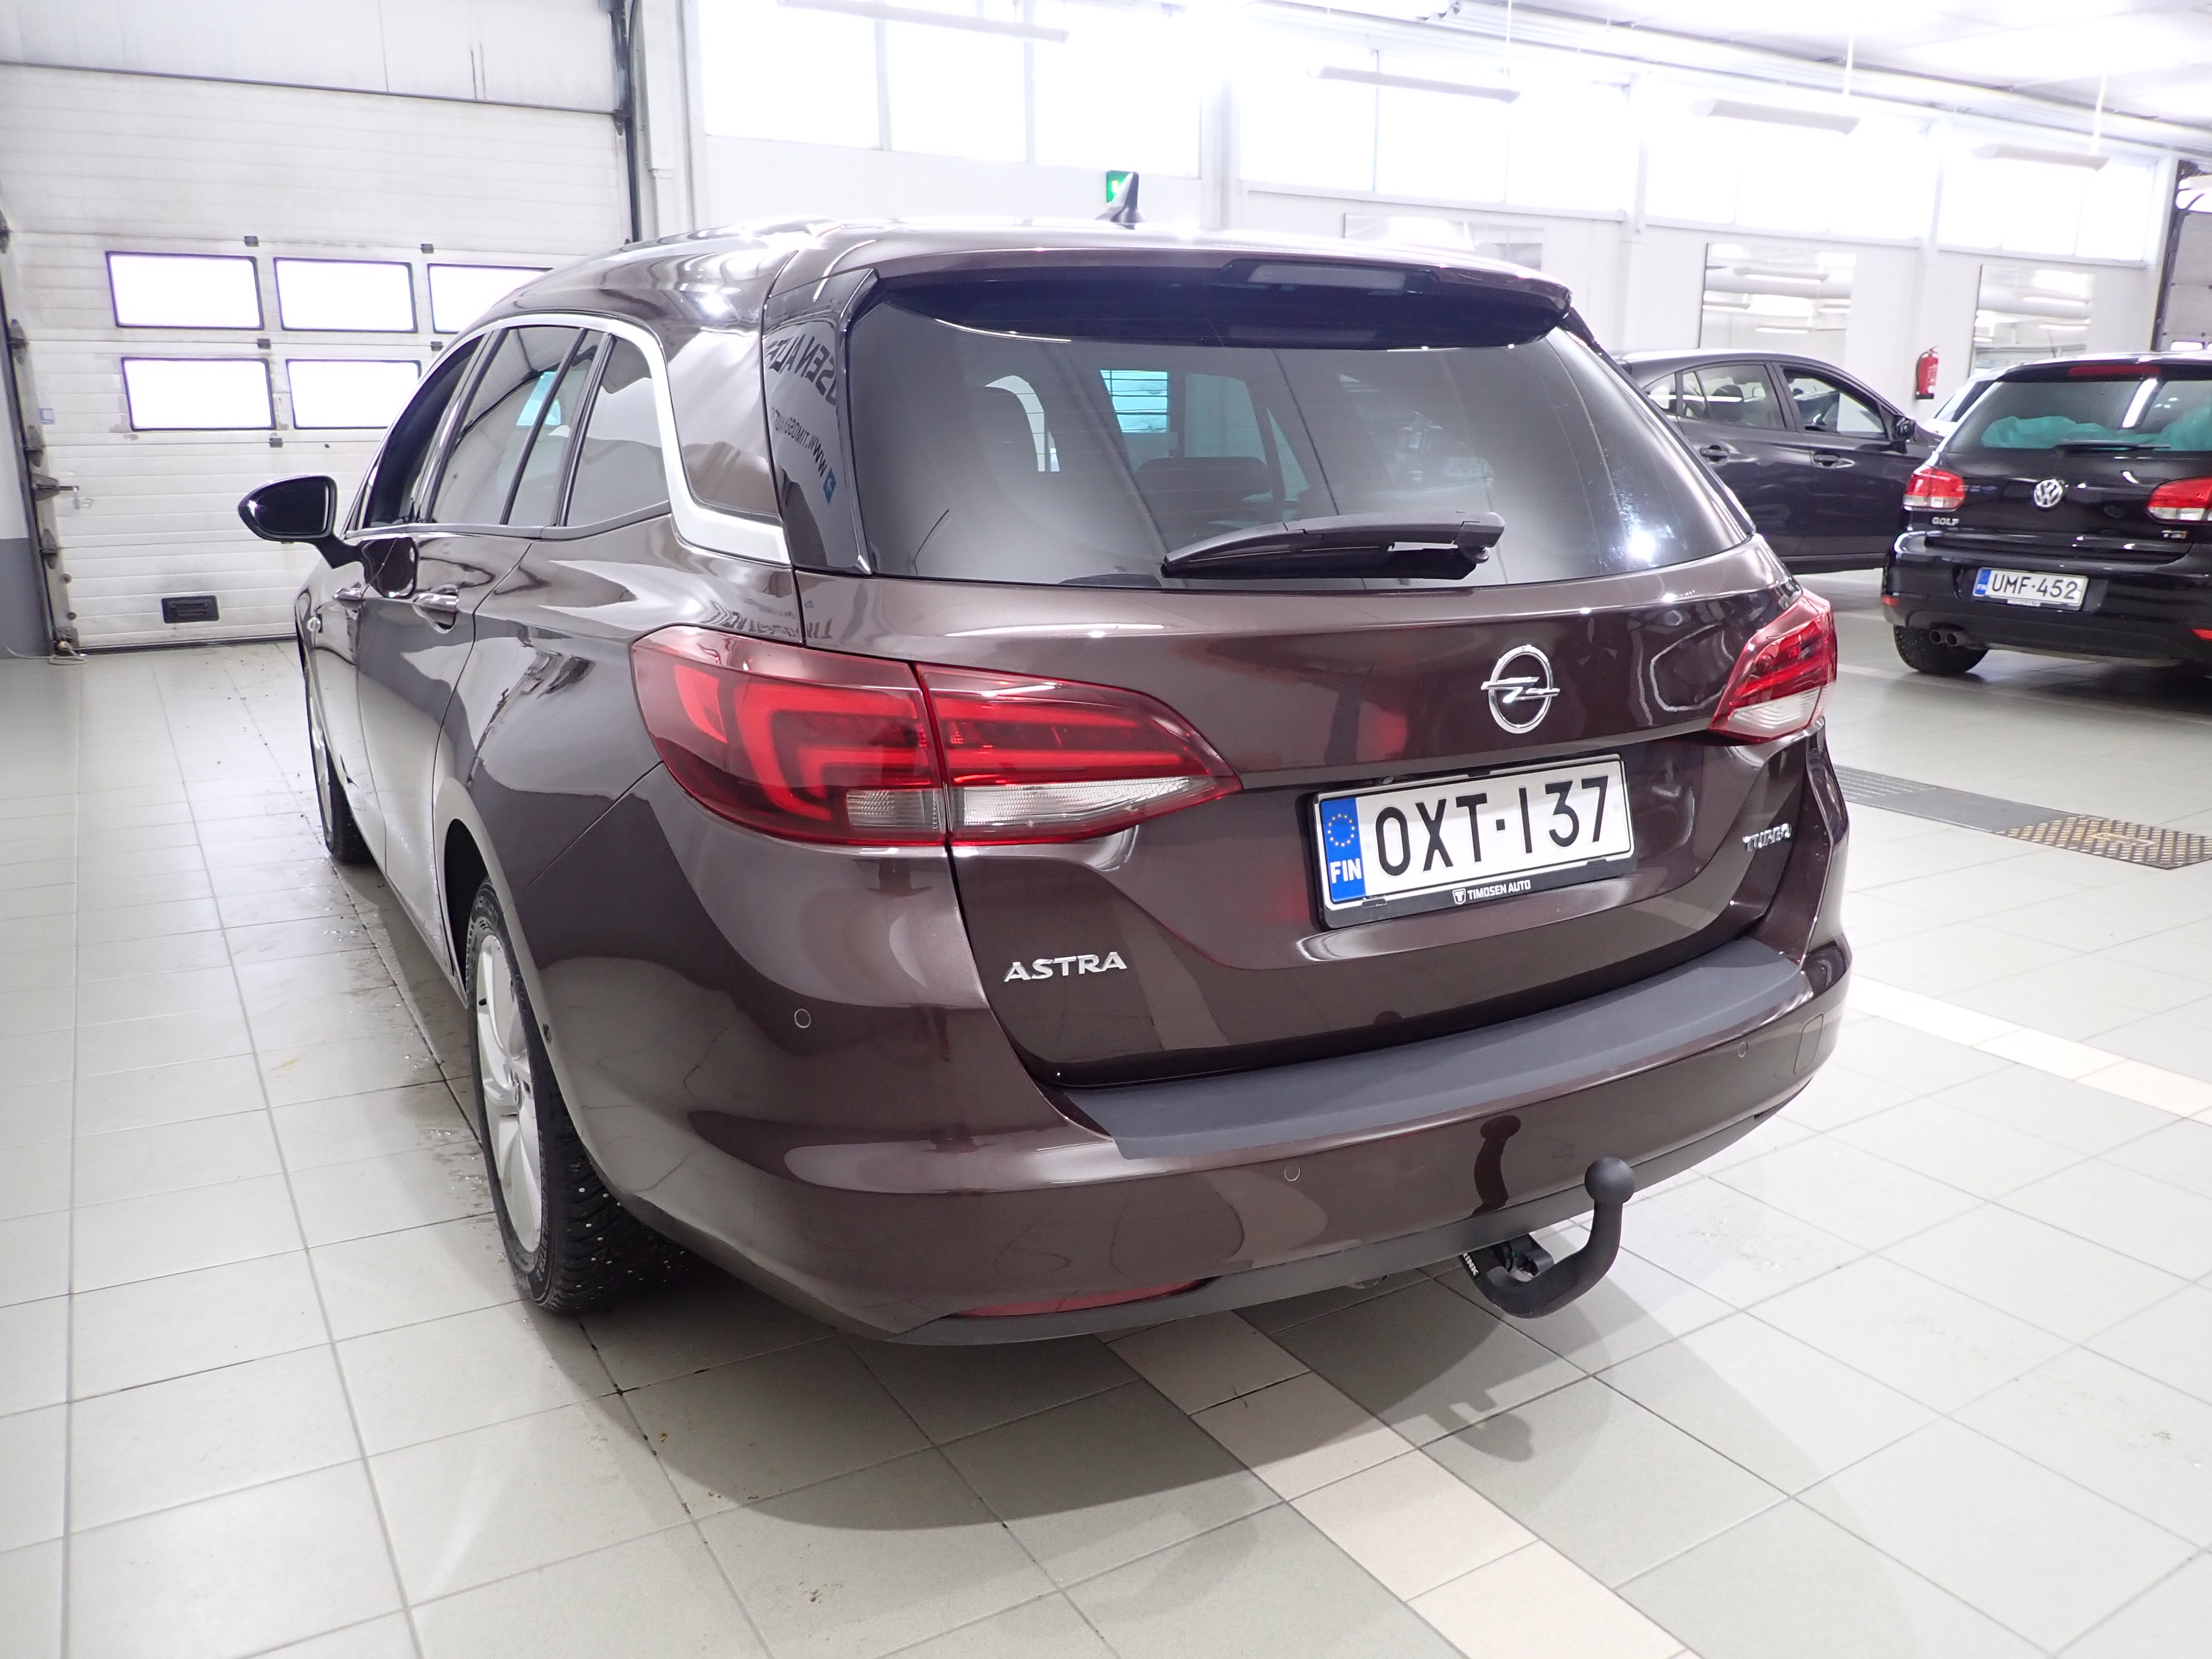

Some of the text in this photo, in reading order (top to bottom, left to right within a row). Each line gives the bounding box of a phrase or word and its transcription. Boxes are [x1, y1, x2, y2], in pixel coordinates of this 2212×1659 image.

[1932, 517, 1959, 526] GOLF
[1992, 573, 2078, 600] UMF-452
[1375, 775, 1609, 877] OXT-137
[1329, 858, 1362, 884] FIN
[1467, 884, 1507, 900] TIMOSEN
[1507, 879, 1531, 893] AUTO
[1003, 951, 1128, 983] ASTRA
